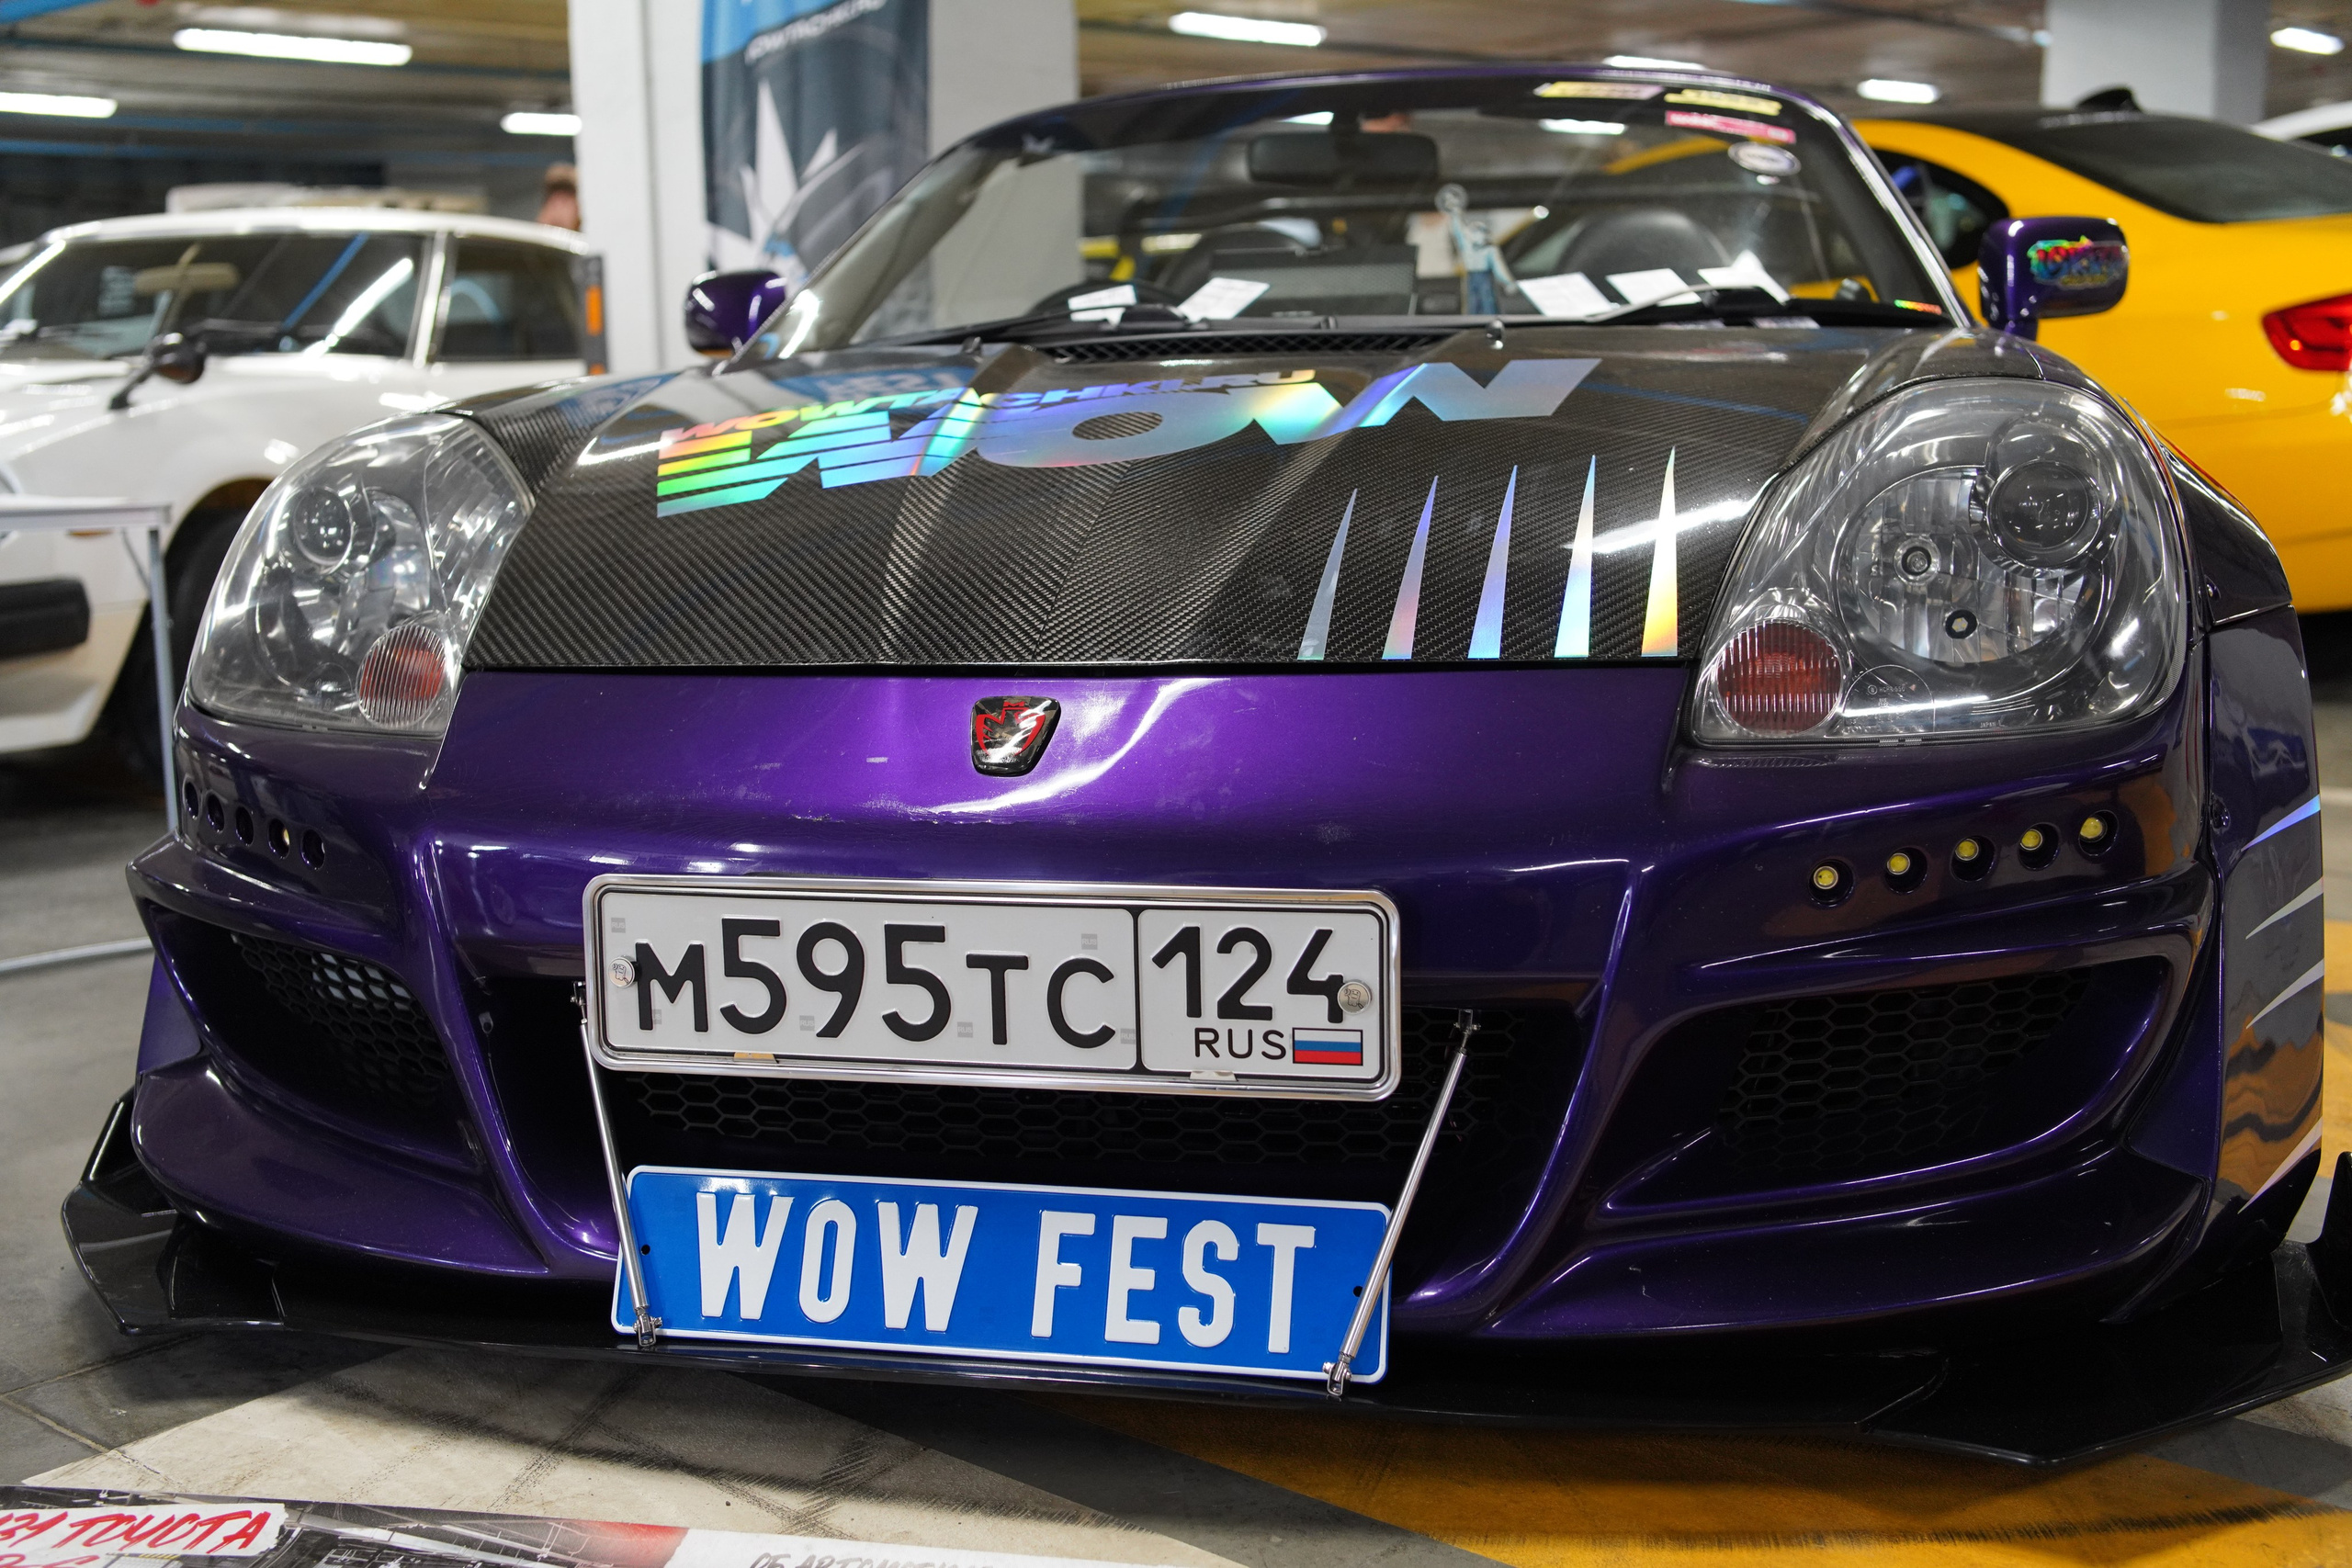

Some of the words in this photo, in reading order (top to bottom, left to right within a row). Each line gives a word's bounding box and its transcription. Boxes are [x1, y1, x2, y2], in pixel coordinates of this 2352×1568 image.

[1152, 927, 1343, 1023] 124
[1194, 1028, 1287, 1060] RUS
[696, 1192, 978, 1332] WOW
[1031, 1210, 1316, 1354] FEST
[51, 1510, 272, 1554] TOYOTA
